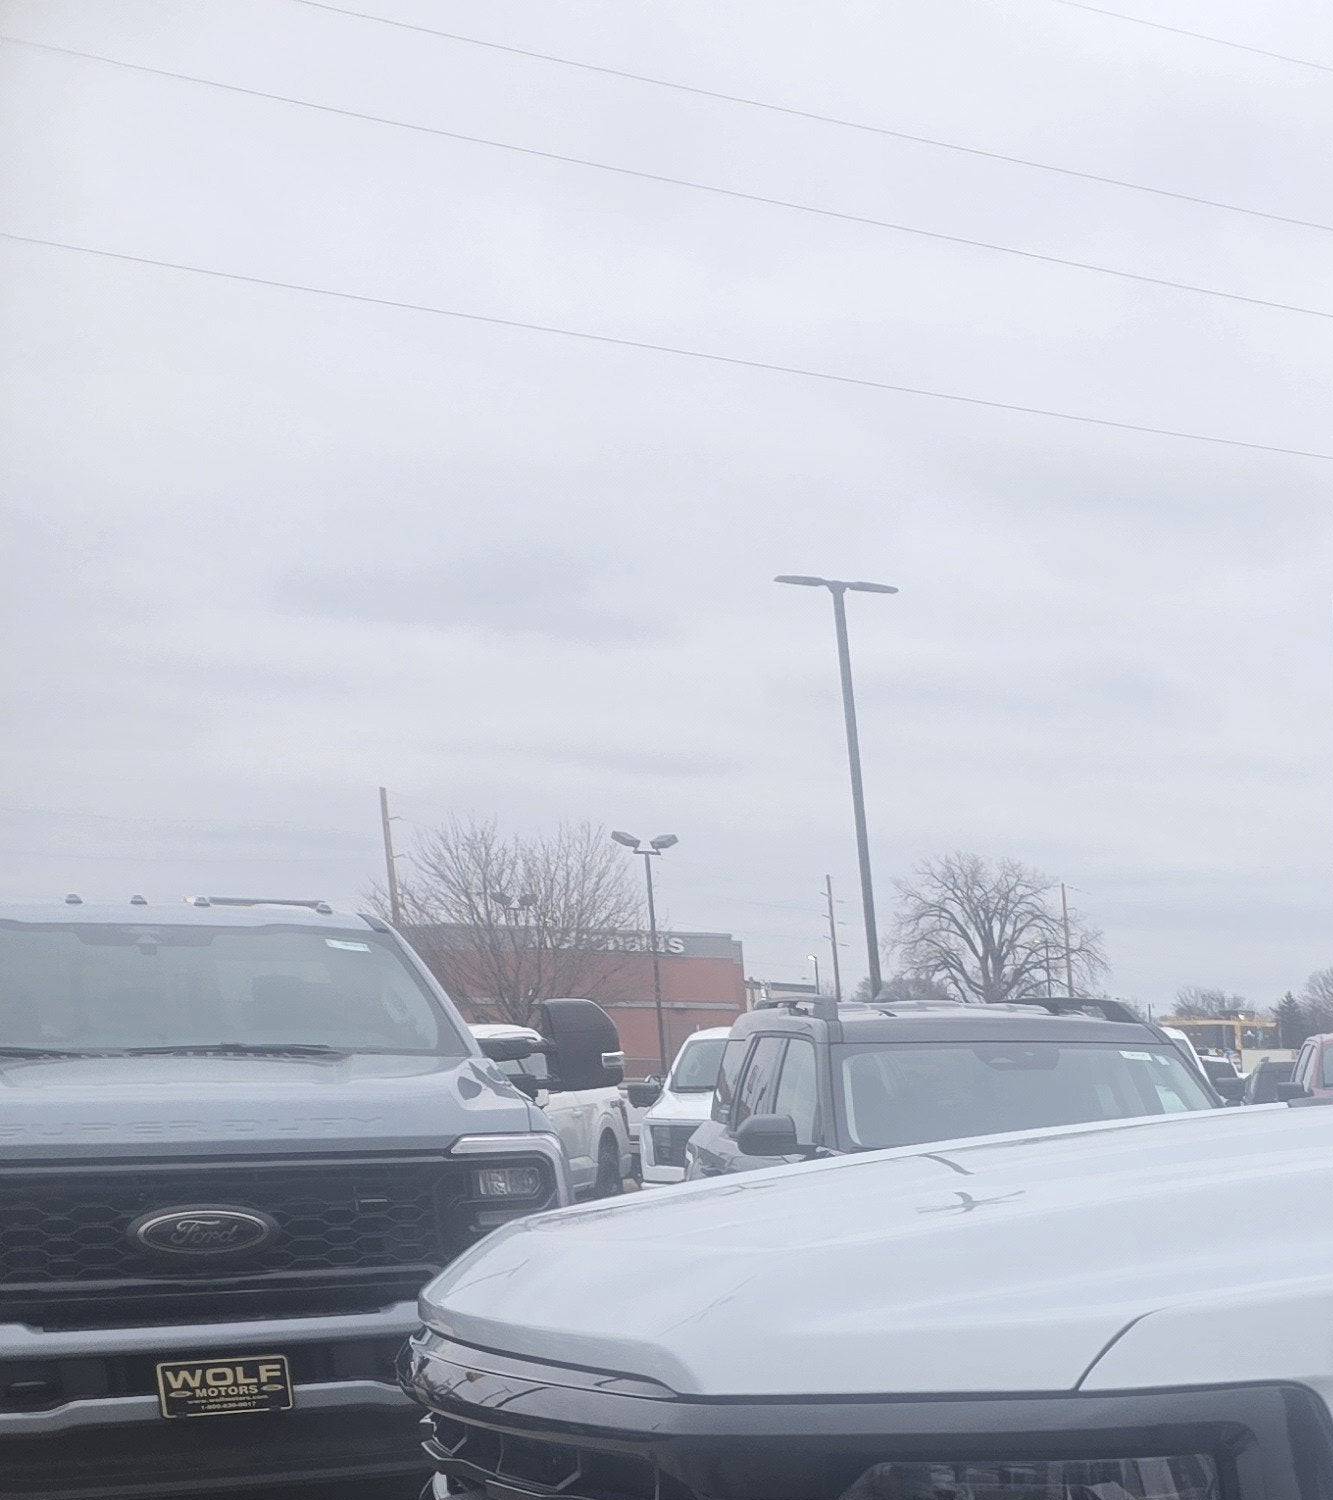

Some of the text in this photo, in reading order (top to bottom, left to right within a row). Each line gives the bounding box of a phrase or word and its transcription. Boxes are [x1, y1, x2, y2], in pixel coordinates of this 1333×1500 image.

[170, 1219, 239, 1245] Ford
[165, 1364, 281, 1389] WOLF
[195, 1384, 259, 1398] MOTORS
